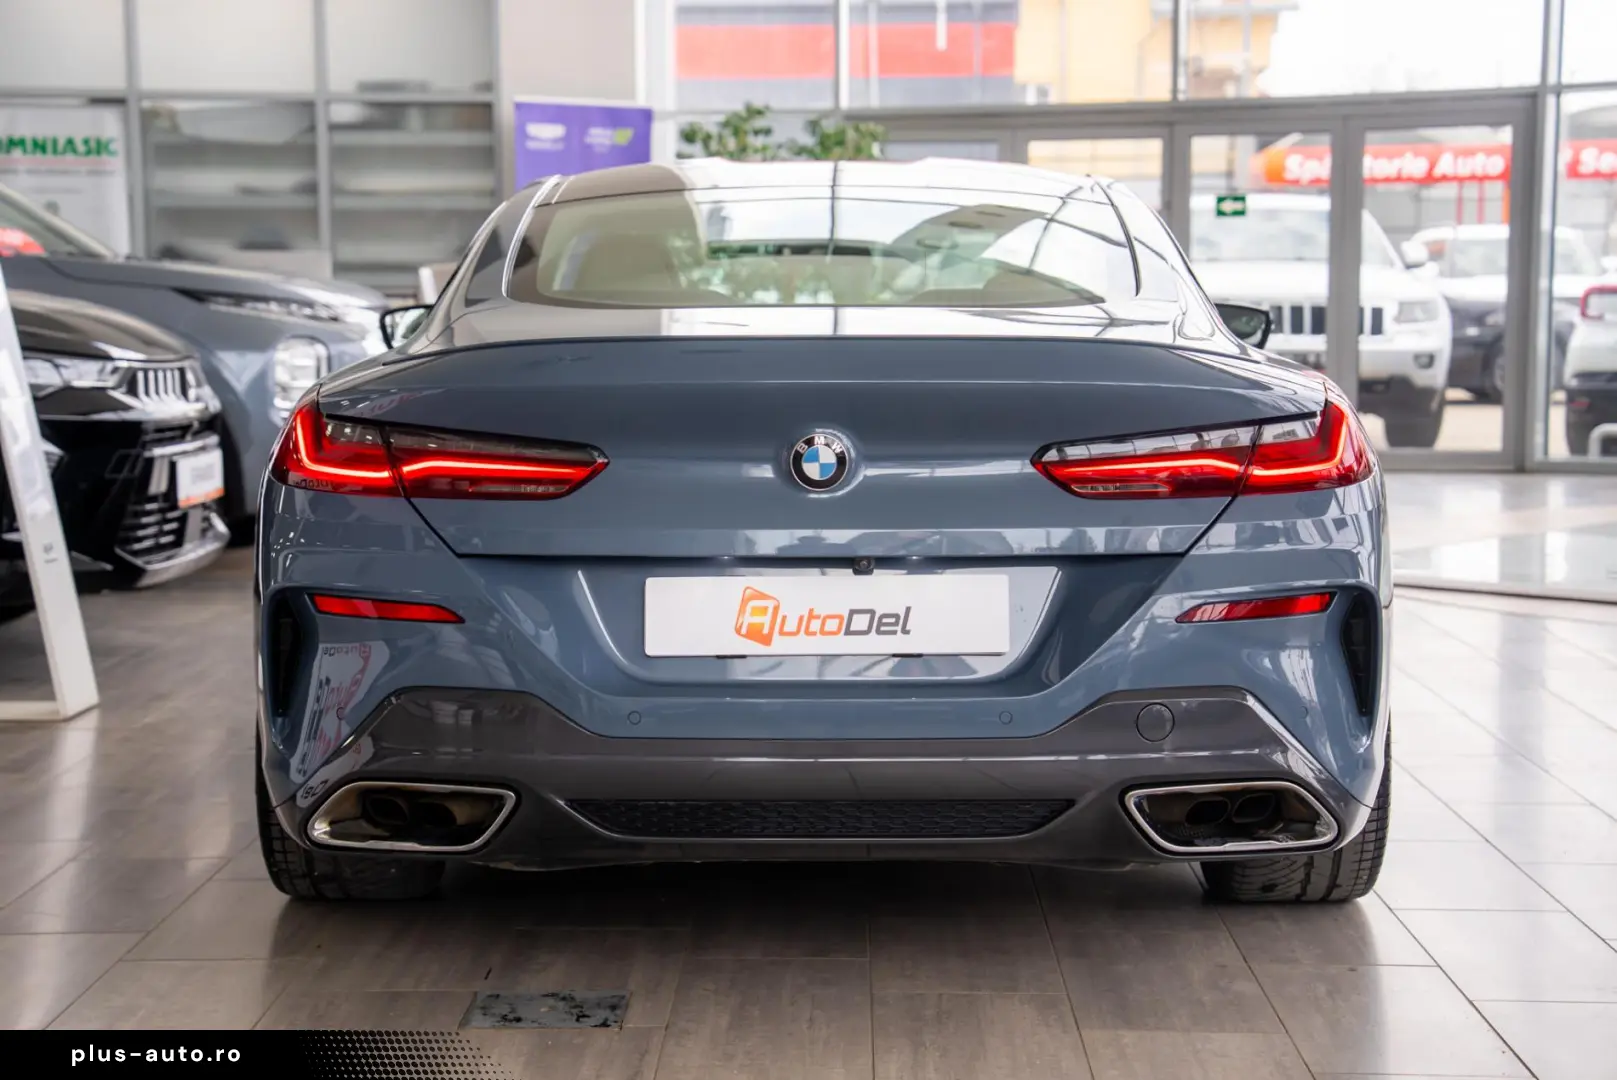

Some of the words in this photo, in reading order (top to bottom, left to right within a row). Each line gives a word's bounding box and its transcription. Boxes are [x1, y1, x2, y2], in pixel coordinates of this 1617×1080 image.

[0, 135, 118, 156] MNIASI
[1431, 152, 1506, 178] Auto
[796, 435, 843, 454] BMW
[738, 594, 912, 638] AutoDel
